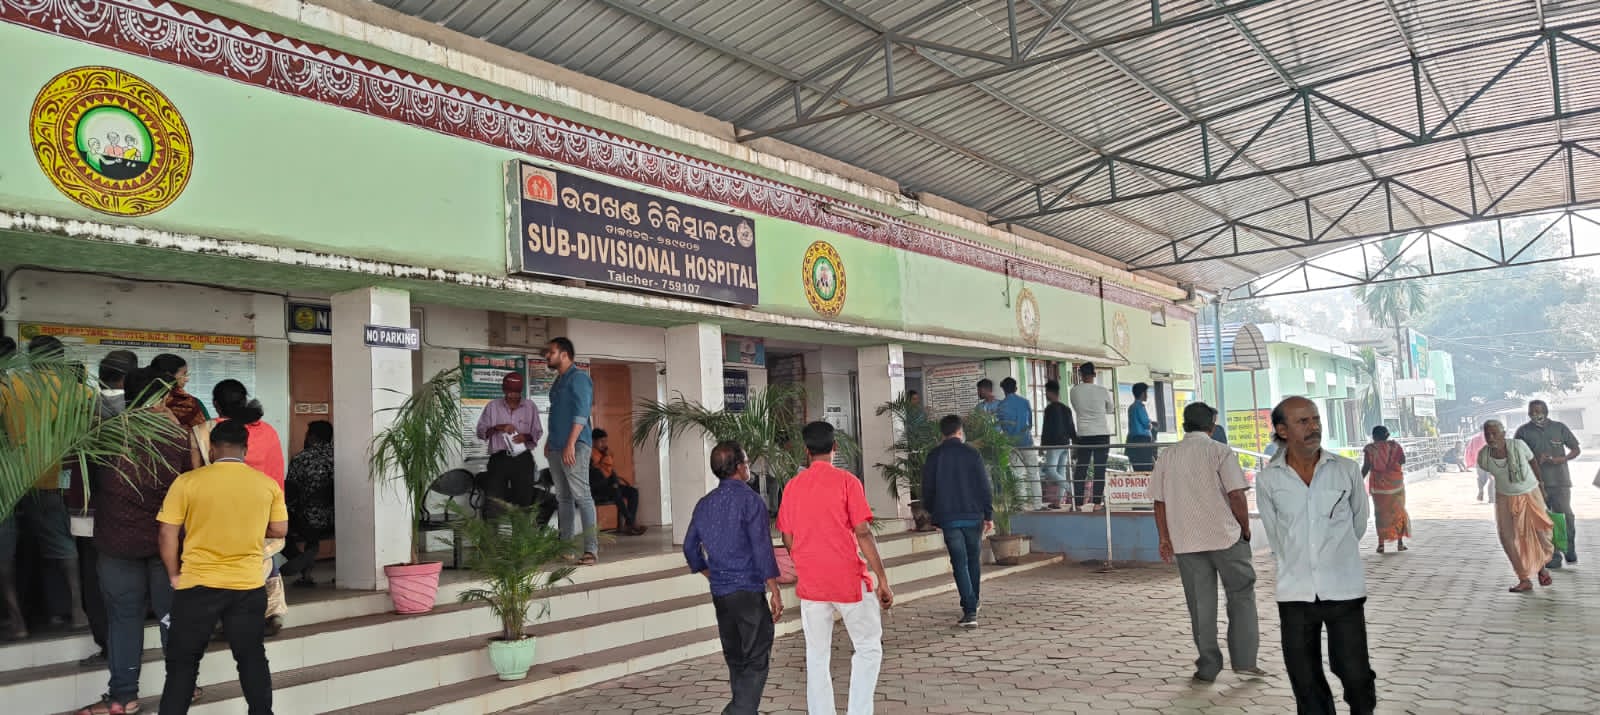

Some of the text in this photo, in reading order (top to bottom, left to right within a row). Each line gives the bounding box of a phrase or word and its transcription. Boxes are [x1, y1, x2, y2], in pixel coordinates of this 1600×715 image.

[561, 187, 736, 246] ଉପଖଣ୍ଡ ଚିକିତ୍ସାଳୟ
[528, 222, 757, 289] SUB-DIVISIONAL HOSPITAL
[662, 279, 700, 294] 759107
[366, 329, 417, 345] NO PARKING
[1110, 478, 1124, 488] NO
